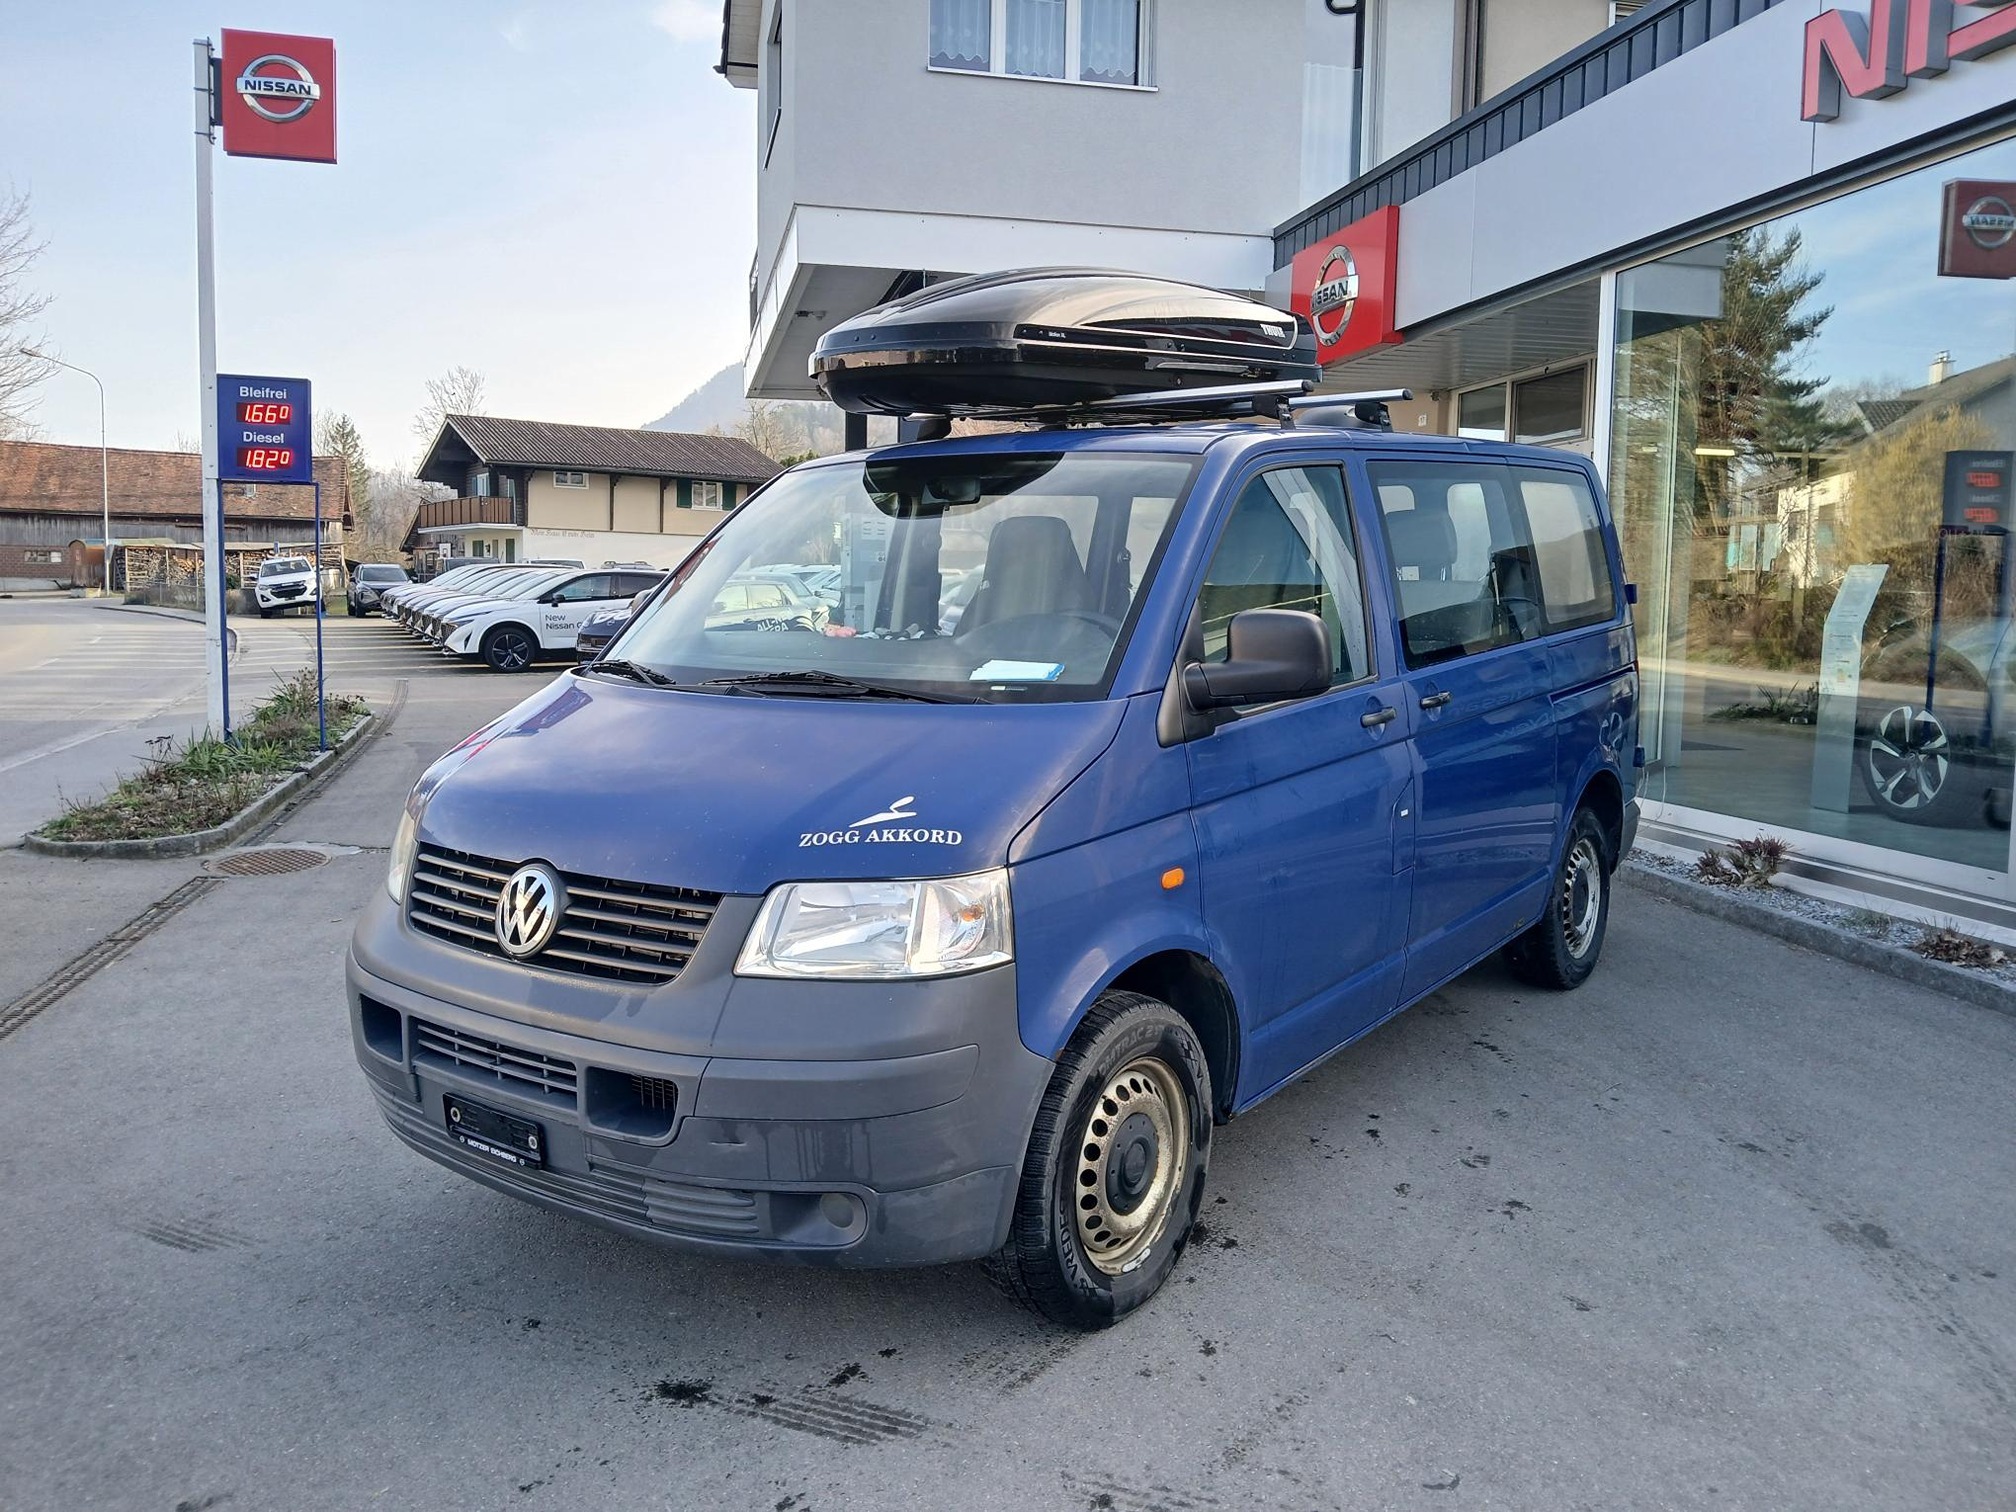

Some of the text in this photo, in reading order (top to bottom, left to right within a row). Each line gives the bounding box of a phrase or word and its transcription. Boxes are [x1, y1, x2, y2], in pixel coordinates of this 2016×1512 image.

[244, 79, 311, 95] NISSAN
[239, 386, 287, 399] Bleifrei
[243, 431, 285, 444] Diesel
[545, 622, 575, 630] Nissan
[798, 829, 963, 847] ZOGG AKKORD
